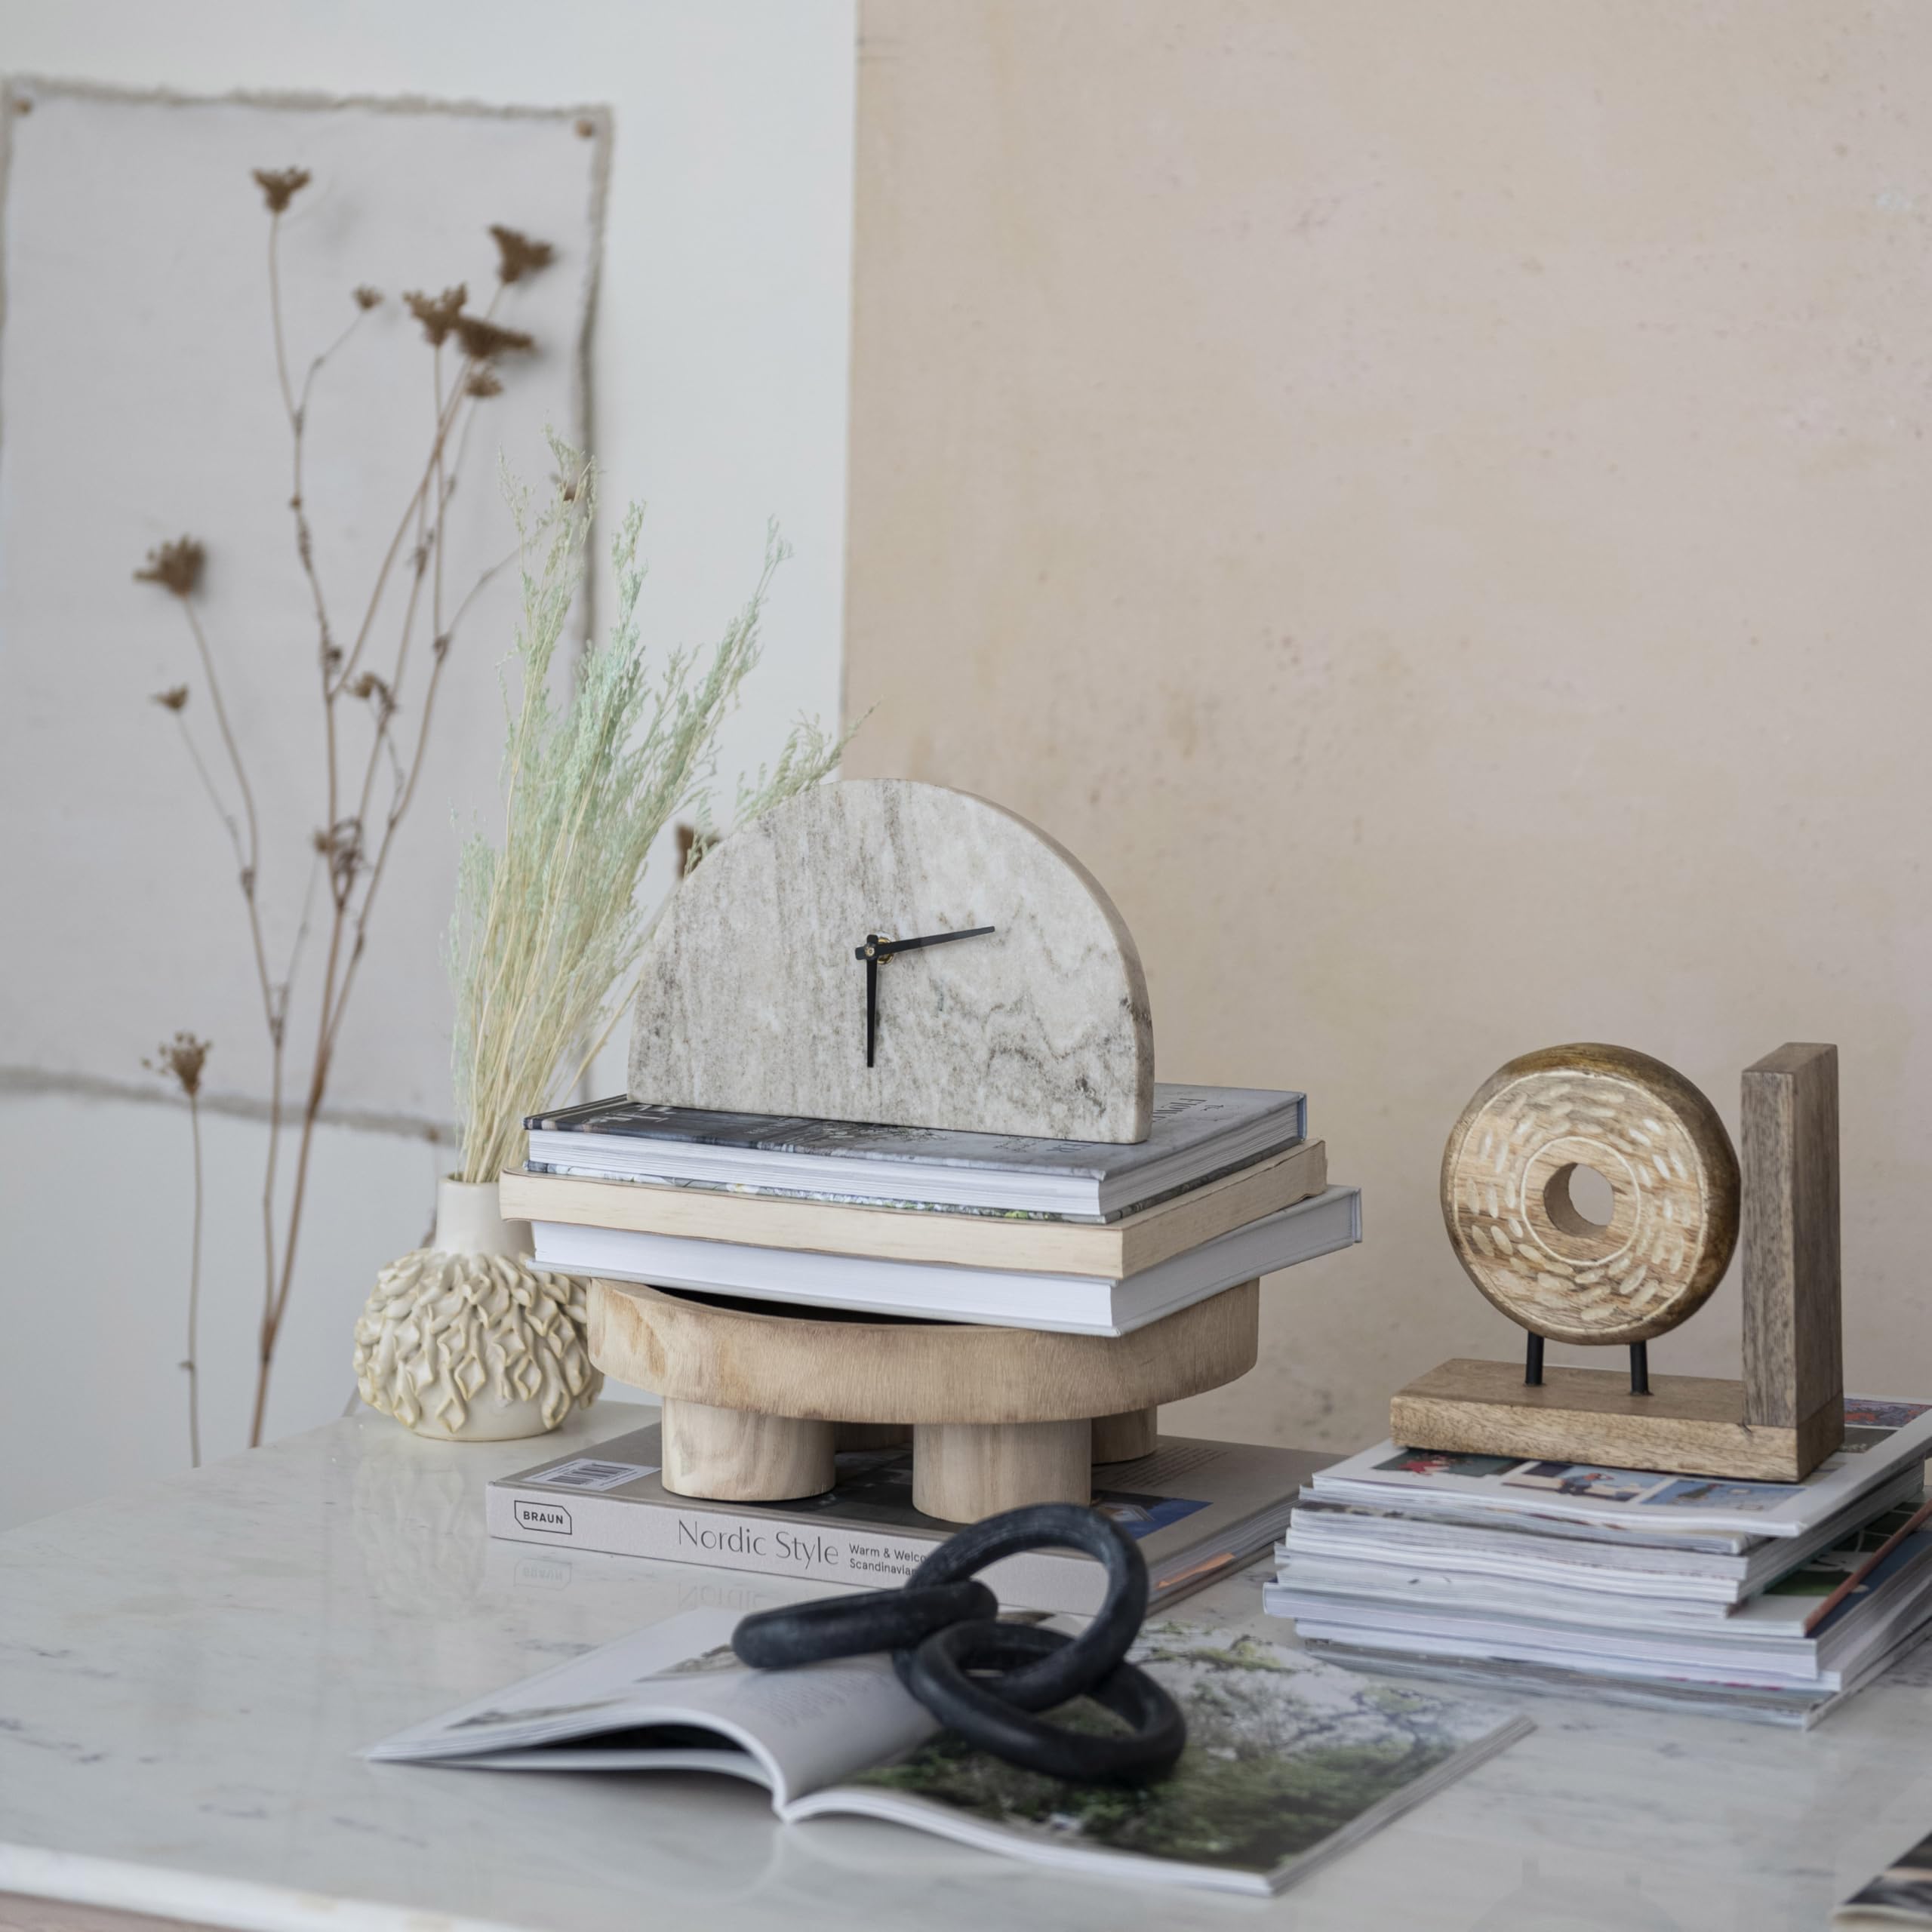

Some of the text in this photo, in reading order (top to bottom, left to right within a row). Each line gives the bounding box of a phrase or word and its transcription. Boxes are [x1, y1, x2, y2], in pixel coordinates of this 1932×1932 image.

[522, 1510, 564, 1524] BRAUN
[678, 1519, 838, 1570] Nordic Style
[848, 1543, 928, 1564] Warm & Welco
